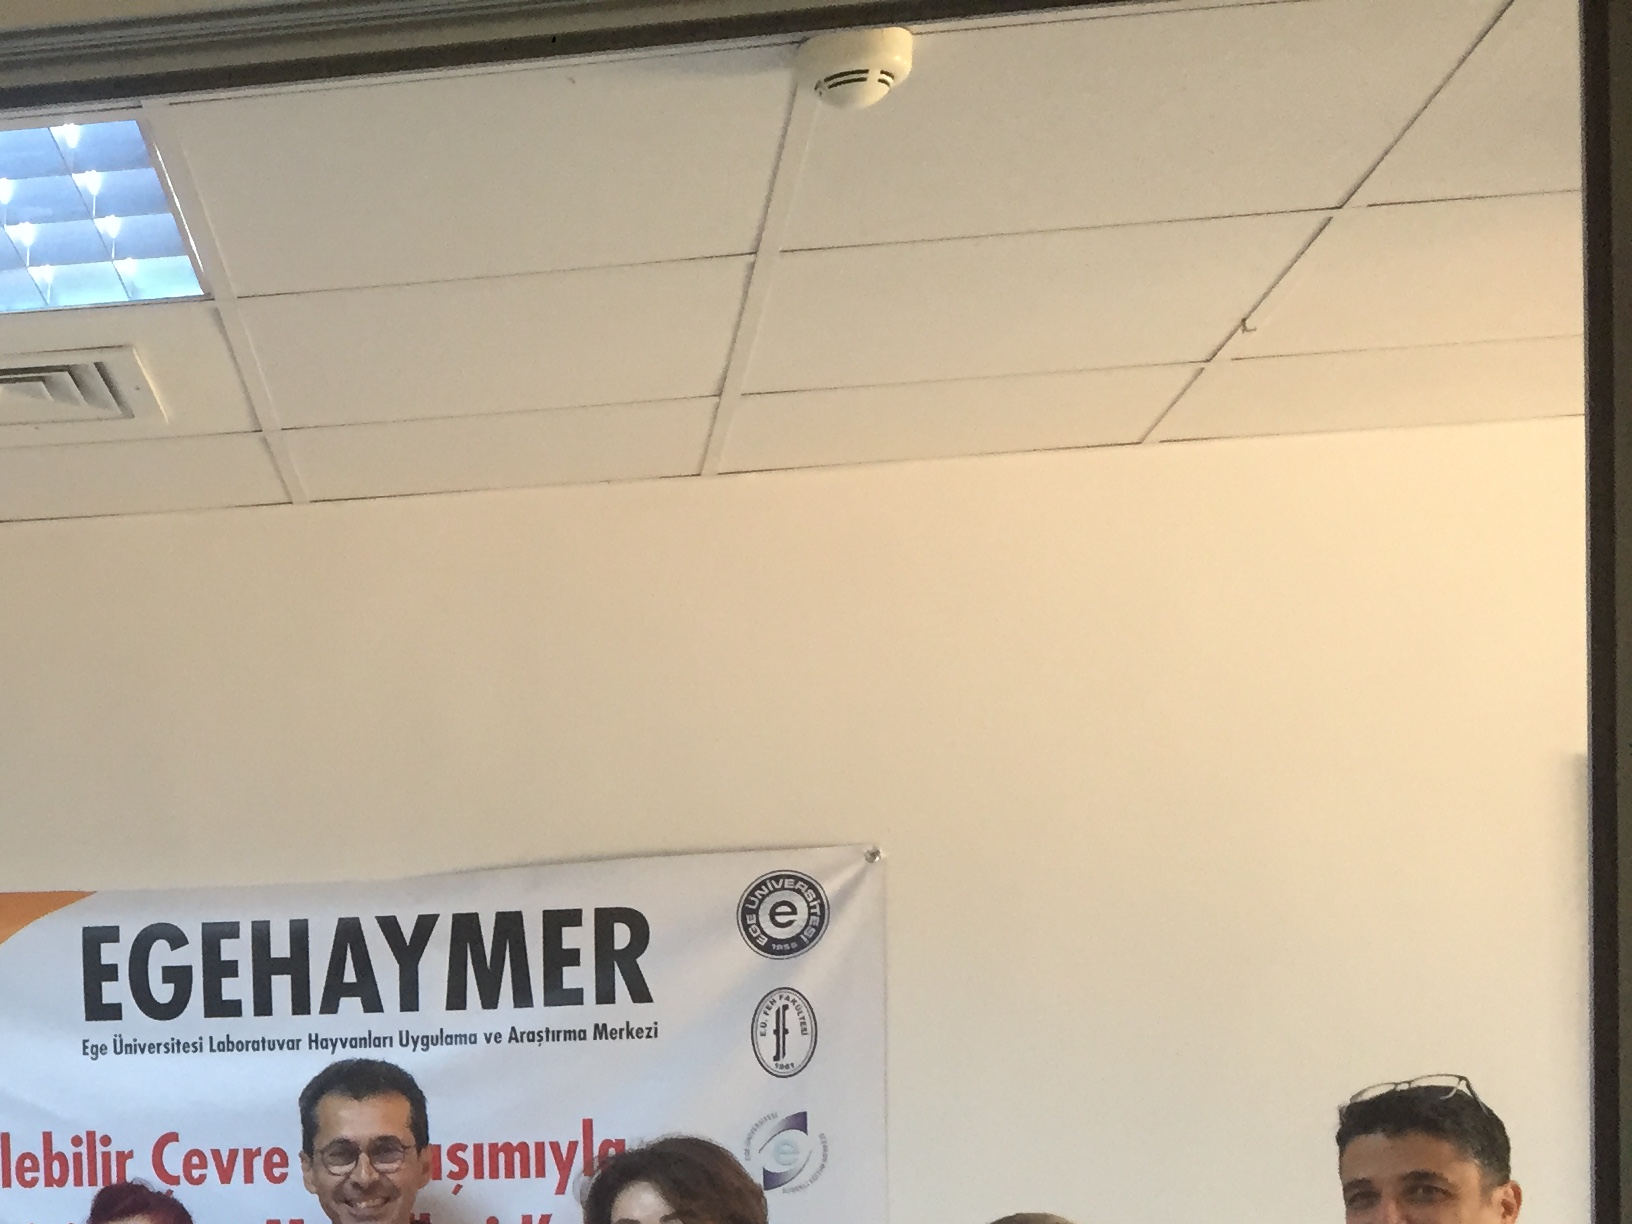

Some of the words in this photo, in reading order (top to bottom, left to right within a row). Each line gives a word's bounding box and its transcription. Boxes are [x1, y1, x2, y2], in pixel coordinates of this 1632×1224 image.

[746, 914, 768, 946] EGE
[82, 907, 654, 1021] EGEHAYMER
[82, 1039, 108, 1061] Ege
[113, 1034, 204, 1056] Üniversitesi
[209, 1034, 302, 1054] Laboratuvar
[308, 1030, 394, 1055] Hayvanları
[398, 1028, 478, 1052] Uygulama
[483, 1030, 503, 1045] ve
[507, 1026, 588, 1047] Araştırma
[592, 1020, 659, 1042] Merkezi
[152, 1132, 289, 1196] Çevre
